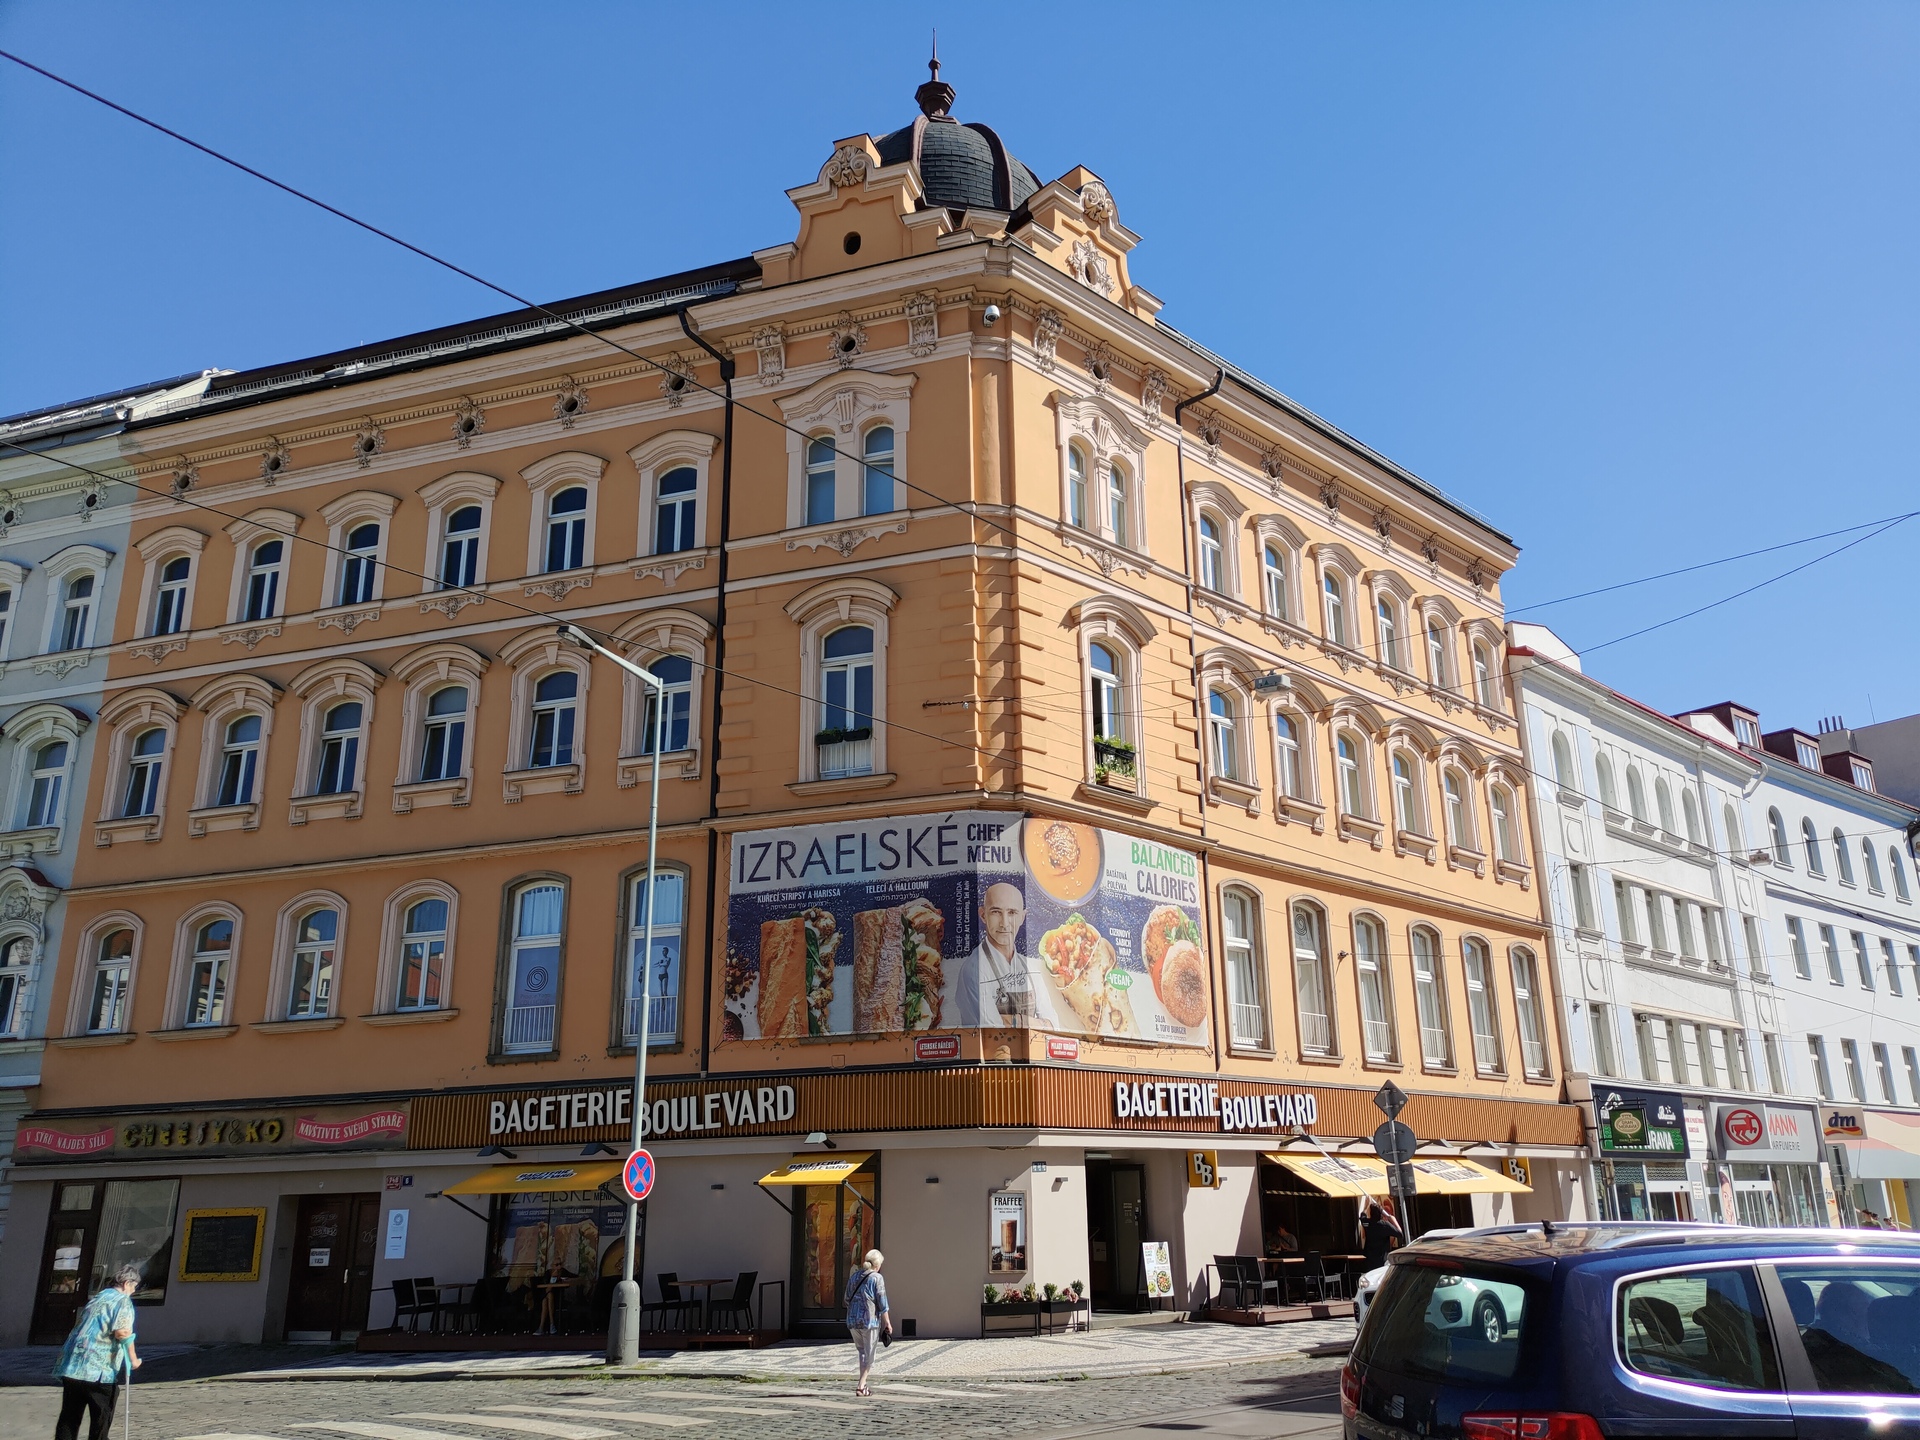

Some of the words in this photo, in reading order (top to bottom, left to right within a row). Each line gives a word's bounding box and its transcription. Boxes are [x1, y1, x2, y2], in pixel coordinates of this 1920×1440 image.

[967, 823, 1004, 841] CHEF
[739, 814, 958, 883] IZRAELSKÉ
[967, 845, 1012, 864] MENU
[1132, 841, 1195, 878] BALANCED
[866, 884, 886, 894] TELECÍ
[896, 880, 929, 891] HALLOUMI
[1107, 880, 1127, 892] POLÉVKA
[1137, 869, 1196, 904] CALORIES
[758, 892, 780, 903] KUŘECÍ
[781, 891, 806, 902] STRIPSY
[814, 888, 840, 898] HARISSA
[1110, 972, 1130, 986] VEGAN
[1155, 1014, 1166, 1023] SOJA
[1160, 1024, 1170, 1033] TOFU
[1171, 1026, 1186, 1034] BURGER
[1116, 1082, 1220, 1118] BAGETERIE
[490, 1088, 632, 1135] BAGETERIE
[642, 1085, 796, 1137] BOULEVARD
[1222, 1094, 1318, 1130] BOULEVARD
[1828, 1112, 1856, 1127] dm
[298, 1122, 340, 1139] NAVŠTIVTE
[343, 1120, 369, 1138] SVÉHO
[371, 1113, 403, 1129] SÝRAŘE
[26, 1132, 31, 1142] V
[34, 1130, 54, 1144] SÝRU
[56, 1137, 86, 1150] NAJDEŠ
[89, 1134, 106, 1148] SÍLU
[1772, 1140, 1800, 1151] ARFUMERIE
[994, 1197, 1022, 1206] FRAFFEE
